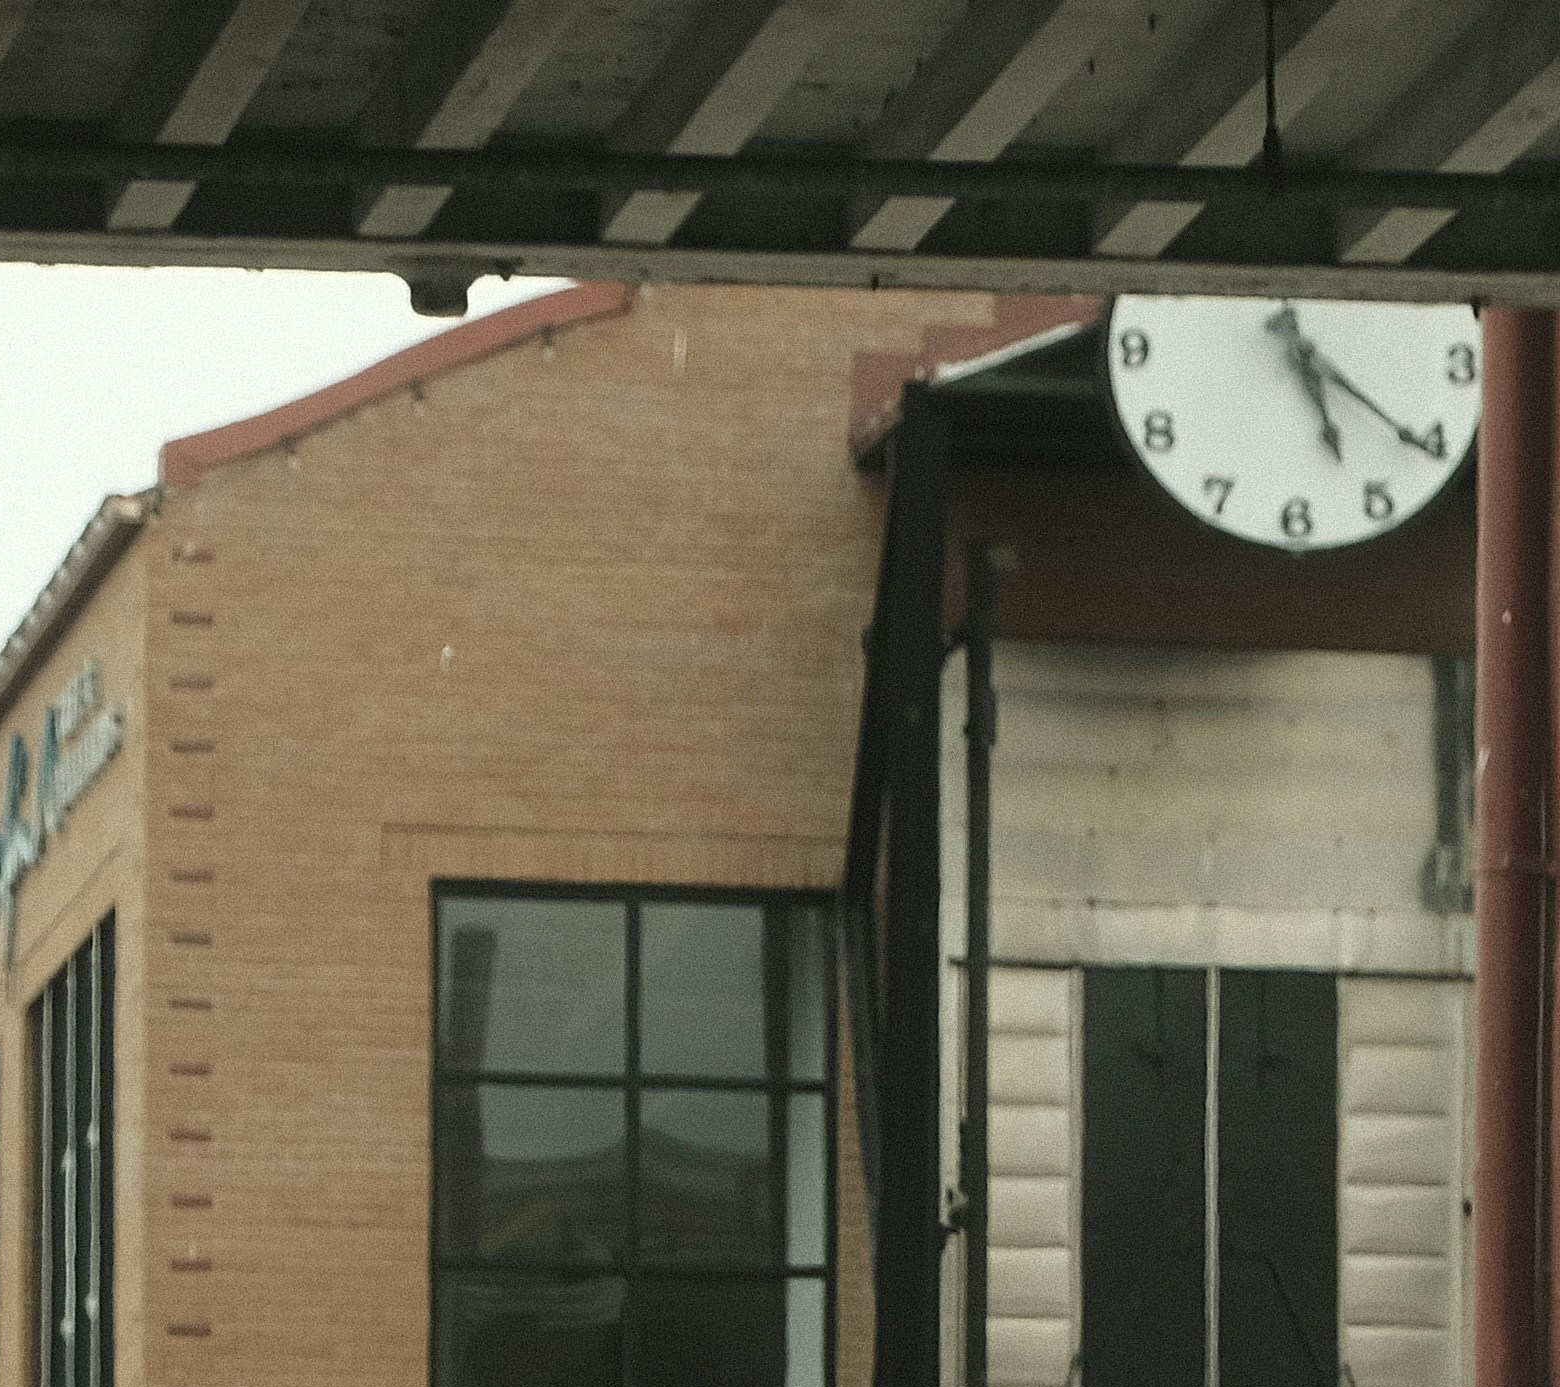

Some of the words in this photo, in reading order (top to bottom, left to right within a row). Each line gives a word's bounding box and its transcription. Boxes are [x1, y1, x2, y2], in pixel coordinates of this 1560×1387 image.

[1120, 328, 1149, 368] 9
[1446, 343, 1475, 386] 3
[1144, 409, 1174, 453] 8
[1203, 474, 1234, 514] 7
[1363, 479, 1393, 520] 5
[1280, 497, 1312, 538] 6
